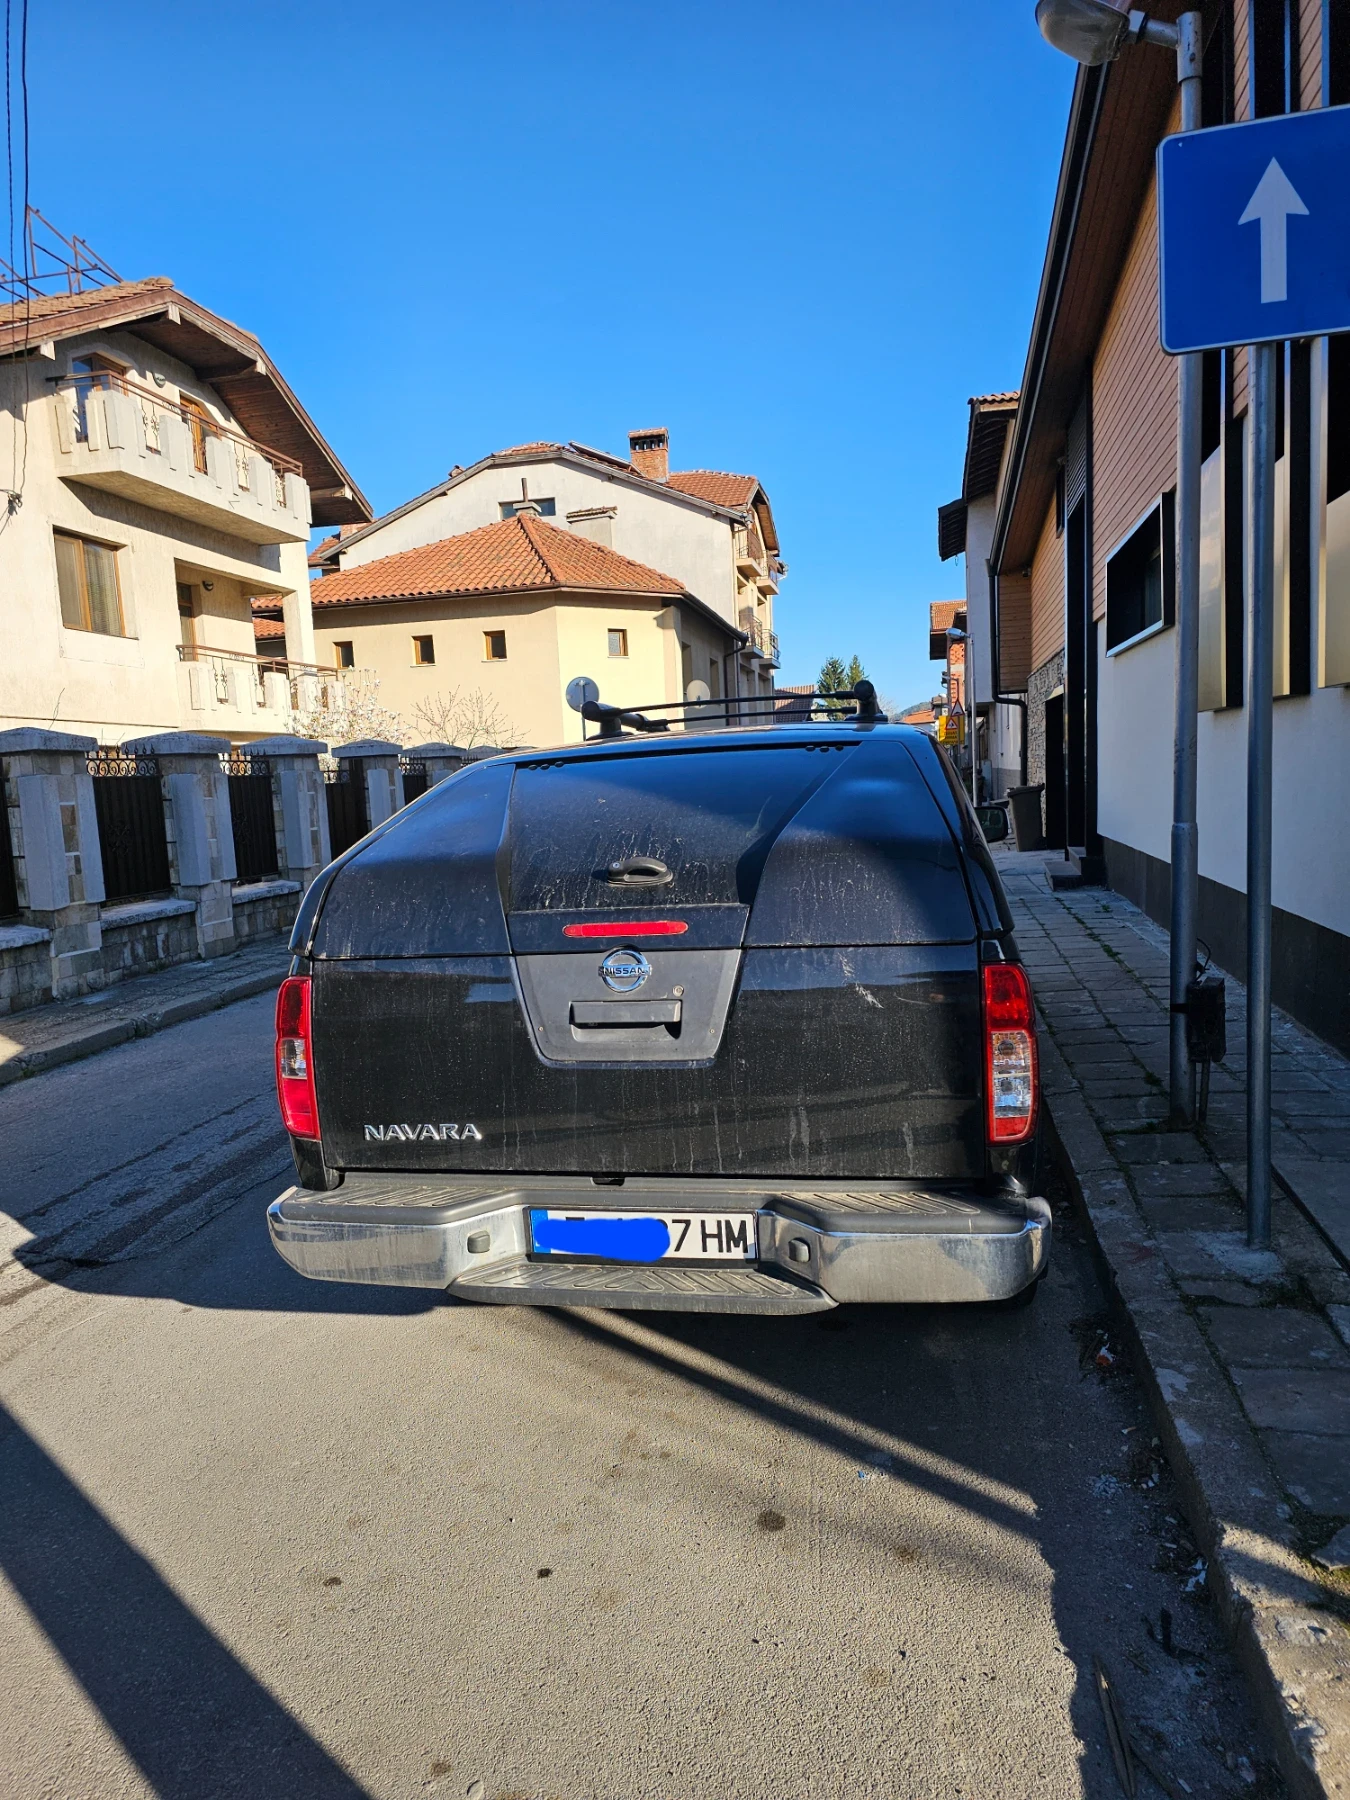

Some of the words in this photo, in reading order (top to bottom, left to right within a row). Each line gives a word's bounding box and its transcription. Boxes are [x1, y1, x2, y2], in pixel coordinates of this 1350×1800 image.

[604, 967, 646, 975] NISSAN
[364, 1123, 482, 1141] NAVARA
[700, 1219, 749, 1254] HM
